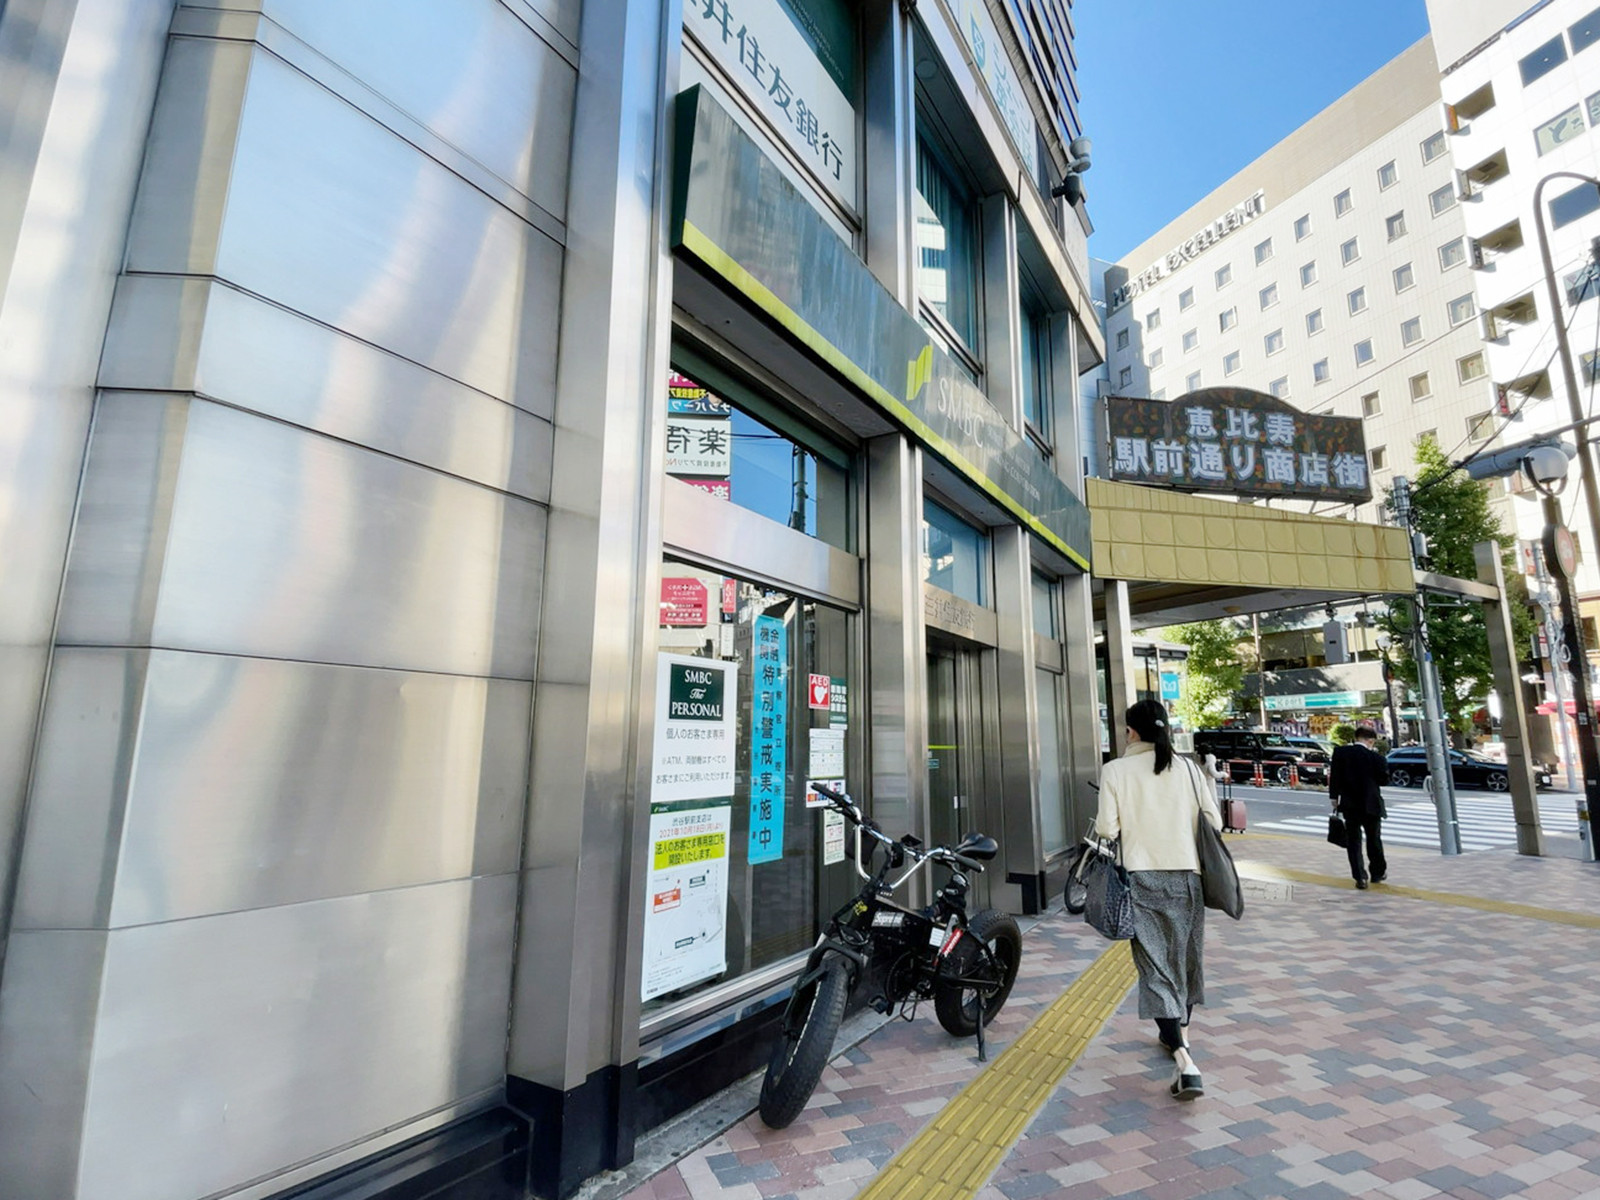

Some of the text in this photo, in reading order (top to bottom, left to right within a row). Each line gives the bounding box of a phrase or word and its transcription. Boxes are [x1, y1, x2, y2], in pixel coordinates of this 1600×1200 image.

[690, 0, 844, 181] 井住友銀行
[1113, 188, 1265, 307] HOTEL EXCELLENT
[938, 378, 985, 448] SMBC
[1185, 406, 1297, 446] 恵比寿
[1114, 437, 1368, 489] 駅前通り商店街
[684, 669, 712, 685] SMBC
[689, 688, 707, 700] The
[811, 676, 829, 687] AED
[671, 702, 722, 718] PERSONAL
[666, 727, 725, 740] 個人のお客さま専用
[759, 664, 775, 850] 特別警戒実施中
